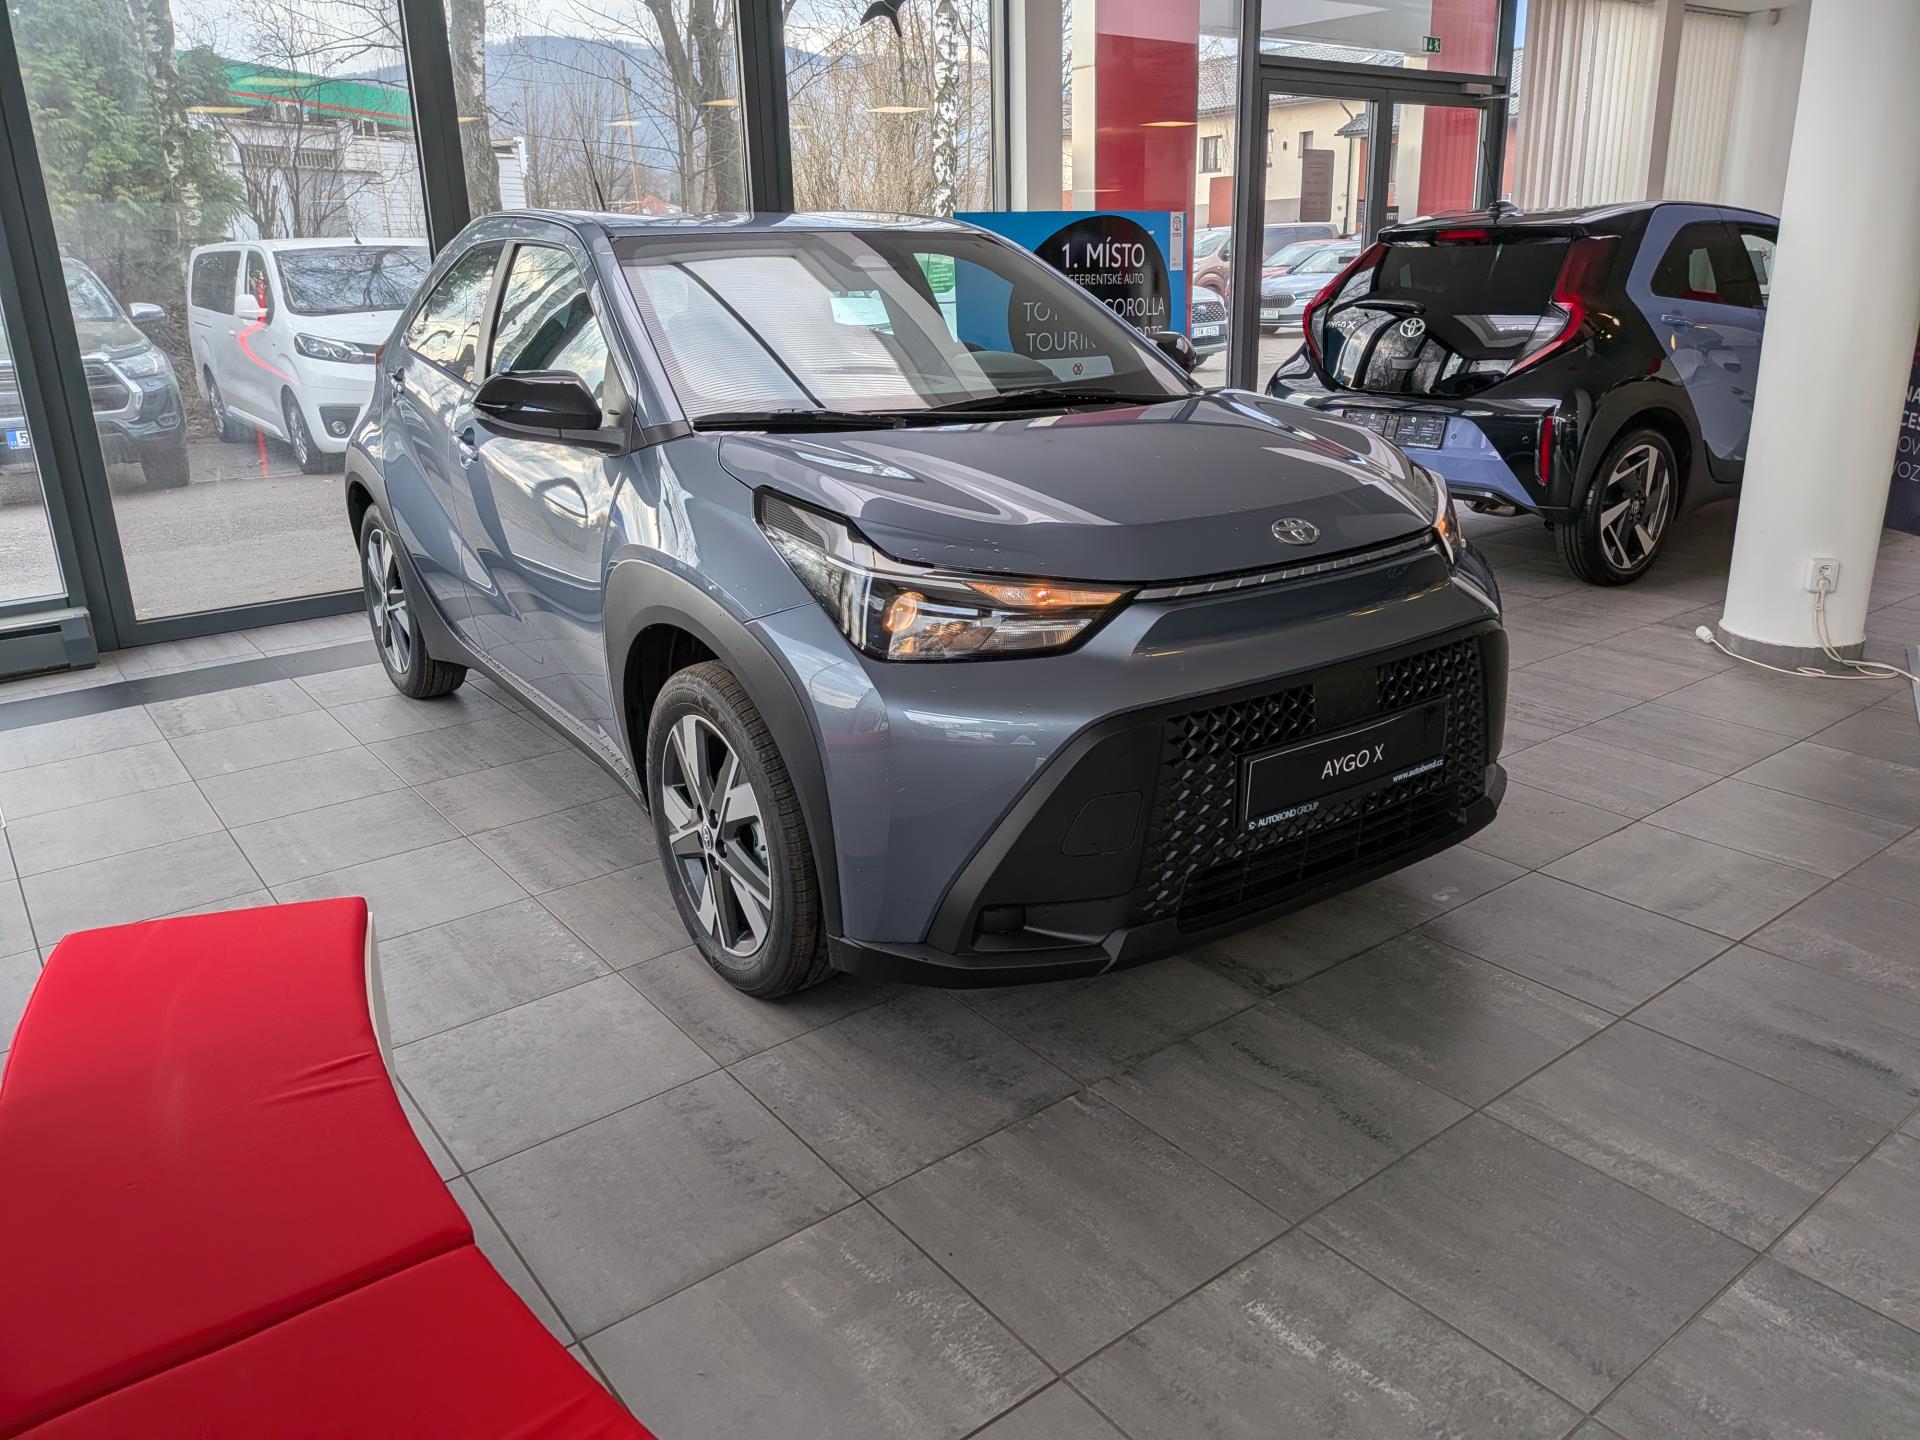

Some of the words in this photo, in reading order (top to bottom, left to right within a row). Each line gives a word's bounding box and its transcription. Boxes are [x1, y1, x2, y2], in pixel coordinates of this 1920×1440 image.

[1062, 243, 1078, 268] 1.
[1086, 236, 1145, 268] MÍSTO
[1065, 271, 1123, 286] EFERENTSKÉ
[1124, 273, 1145, 284] AUTO
[1321, 750, 1370, 780] AYGO
[1373, 743, 1385, 763] X
[1392, 758, 1443, 782] www.autobond.cz
[1258, 809, 1297, 828] AUTOBOND
[1297, 801, 1320, 815] GROUP
